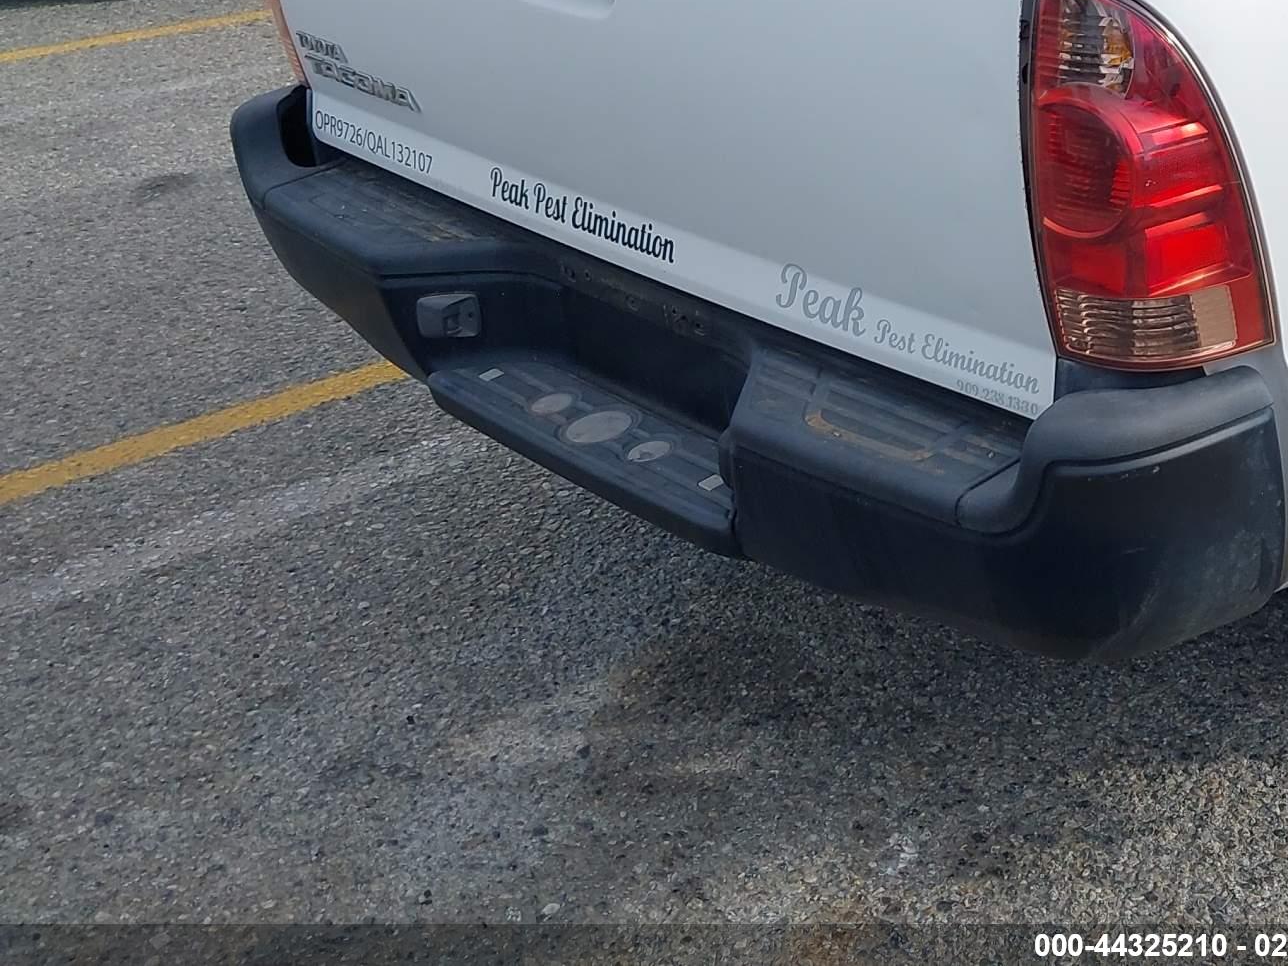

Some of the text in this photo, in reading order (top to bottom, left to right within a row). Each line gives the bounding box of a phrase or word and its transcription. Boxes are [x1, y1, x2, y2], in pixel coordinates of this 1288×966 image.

[304, 52, 423, 114] TACOMA
[315, 110, 433, 174] OPR9726/QAL132107
[490, 166, 675, 264] Peak Pest Elimination
[776, 262, 1040, 395] Peak Pest Elimination
